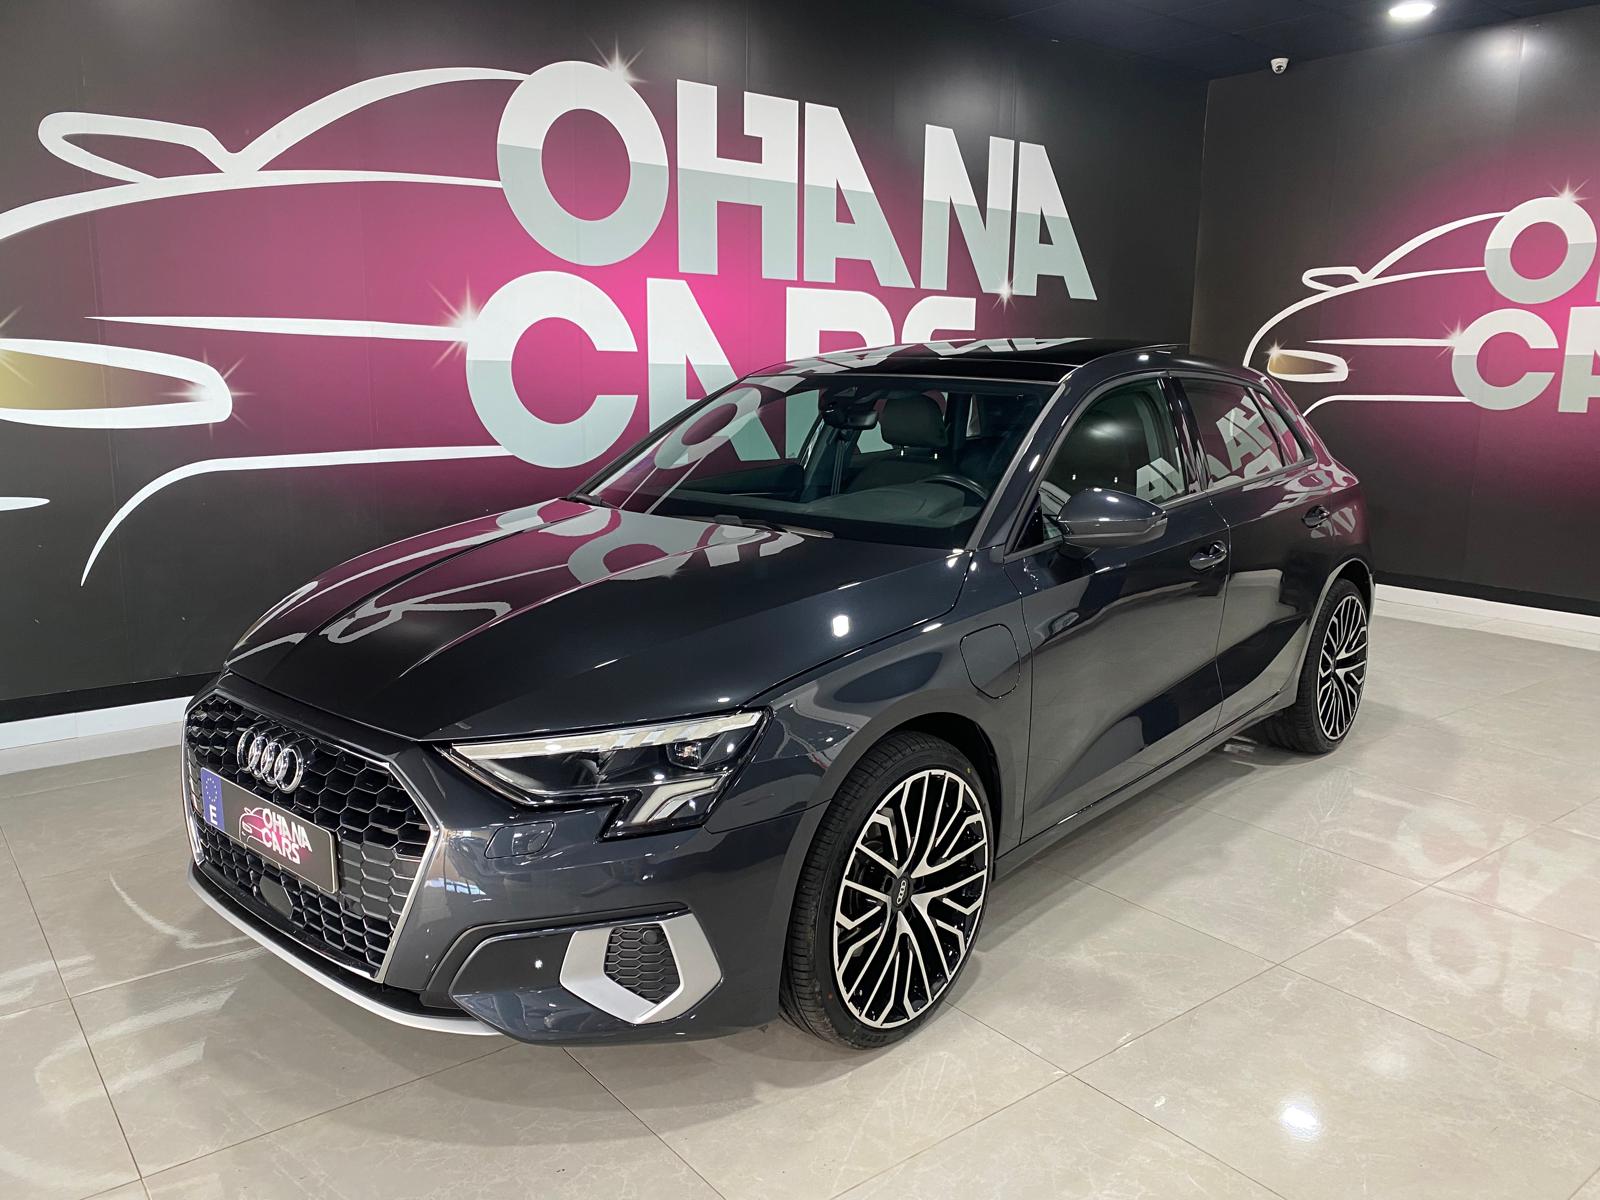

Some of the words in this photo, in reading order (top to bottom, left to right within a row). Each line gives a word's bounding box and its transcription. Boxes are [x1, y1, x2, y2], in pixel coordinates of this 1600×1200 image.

[497, 60, 1098, 301] OHANA
[1484, 196, 1600, 304] O
[209, 804, 218, 826] E
[262, 808, 313, 852] OHANA
[261, 828, 301, 865] CARS
